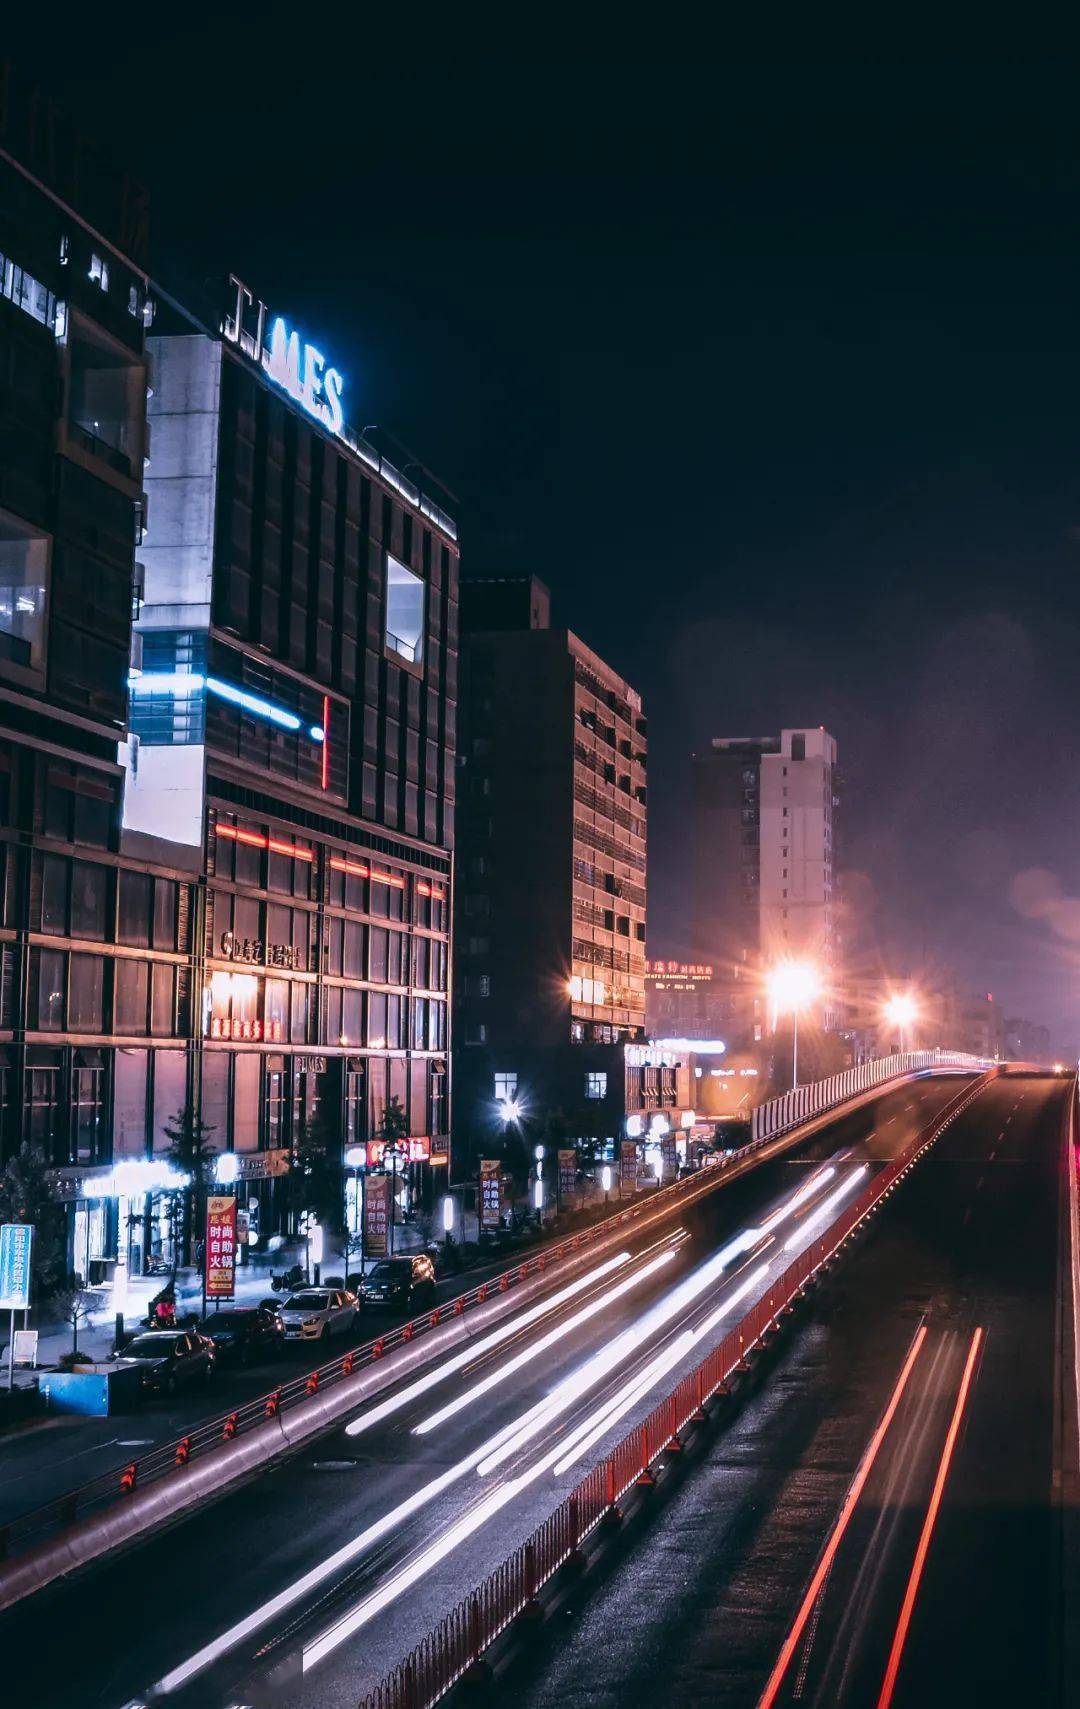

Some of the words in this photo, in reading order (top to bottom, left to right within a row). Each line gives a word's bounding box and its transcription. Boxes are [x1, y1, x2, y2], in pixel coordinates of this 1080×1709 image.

[229, 273, 343, 432] TIMES
[367, 1200, 386, 1210] 时尚
[368, 1212, 386, 1222] 自助
[210, 1226, 233, 1239] 时尚
[367, 1224, 386, 1234] 火锅
[211, 1241, 233, 1253] 自助
[210, 1255, 233, 1268] 火锅
